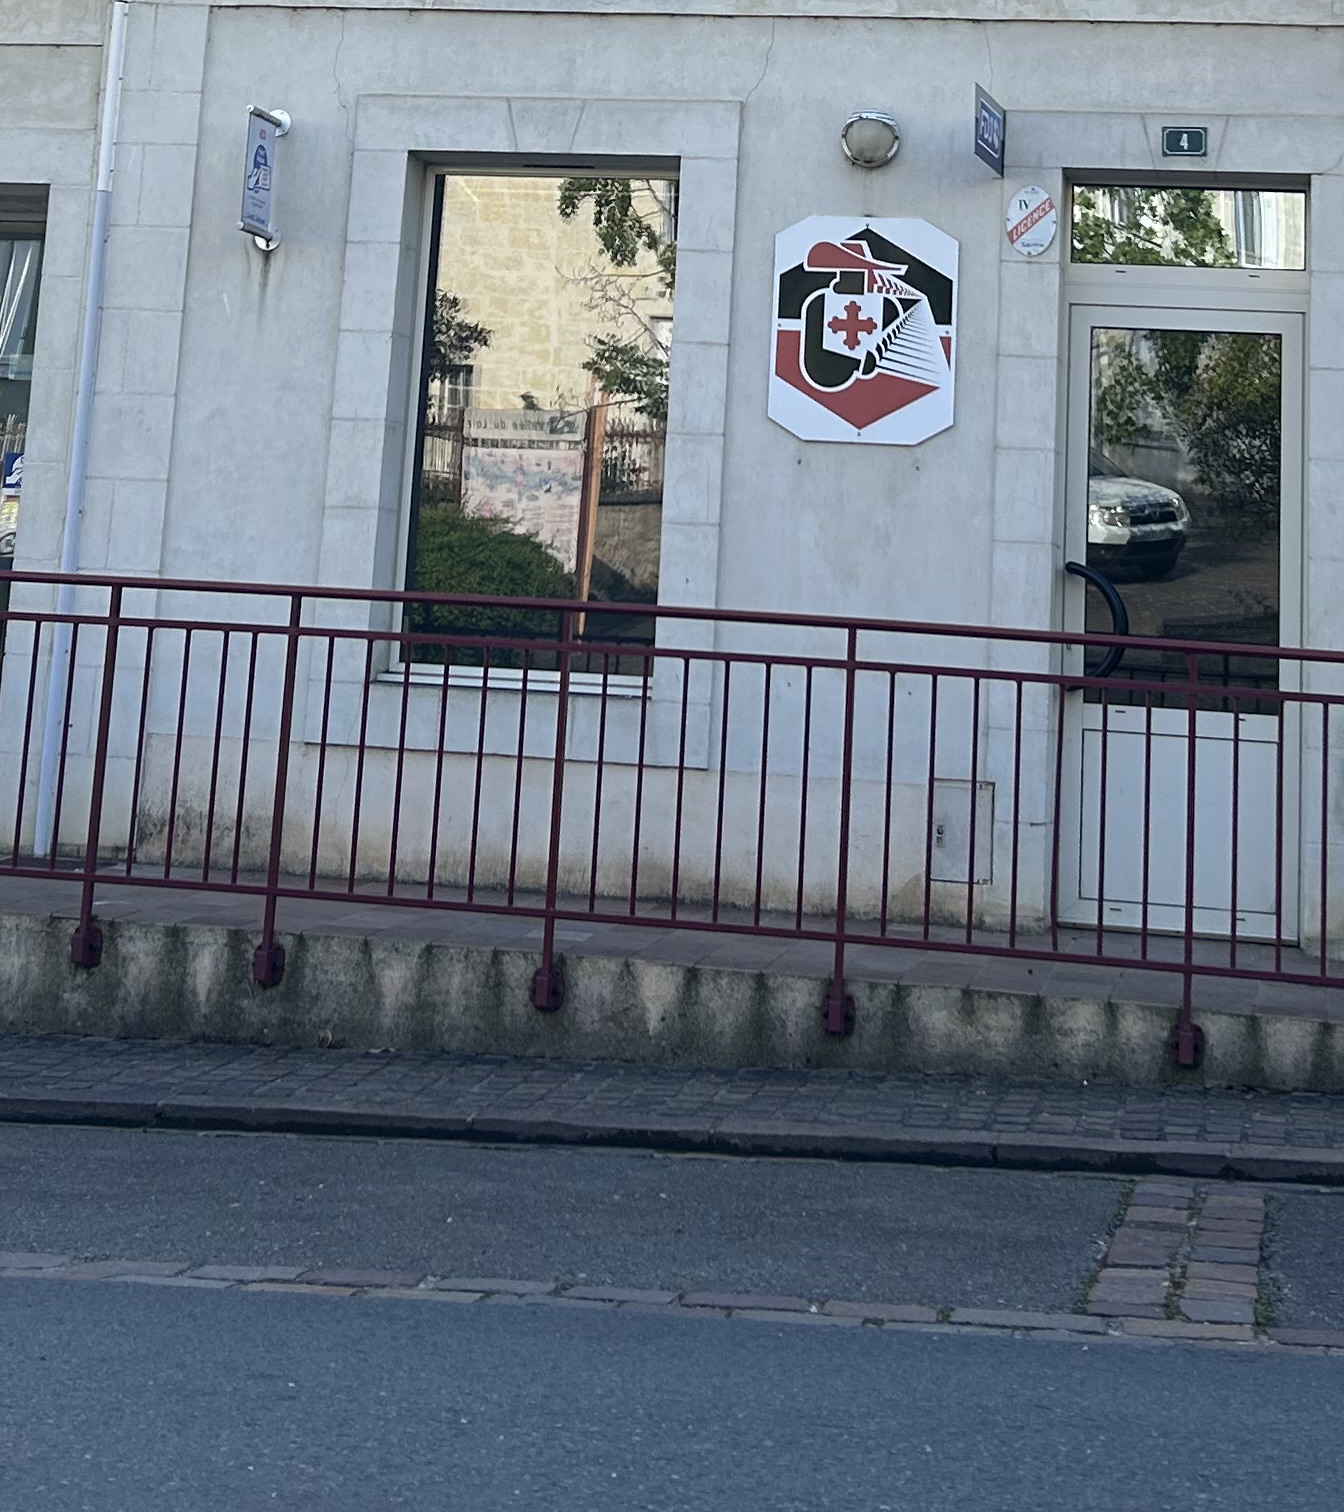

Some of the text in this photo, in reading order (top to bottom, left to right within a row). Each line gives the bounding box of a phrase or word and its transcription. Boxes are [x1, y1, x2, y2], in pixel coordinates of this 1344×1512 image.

[1179, 133, 1188, 151] 4
[1018, 199, 1031, 211] IV
[1012, 199, 1052, 242] LICENCE
